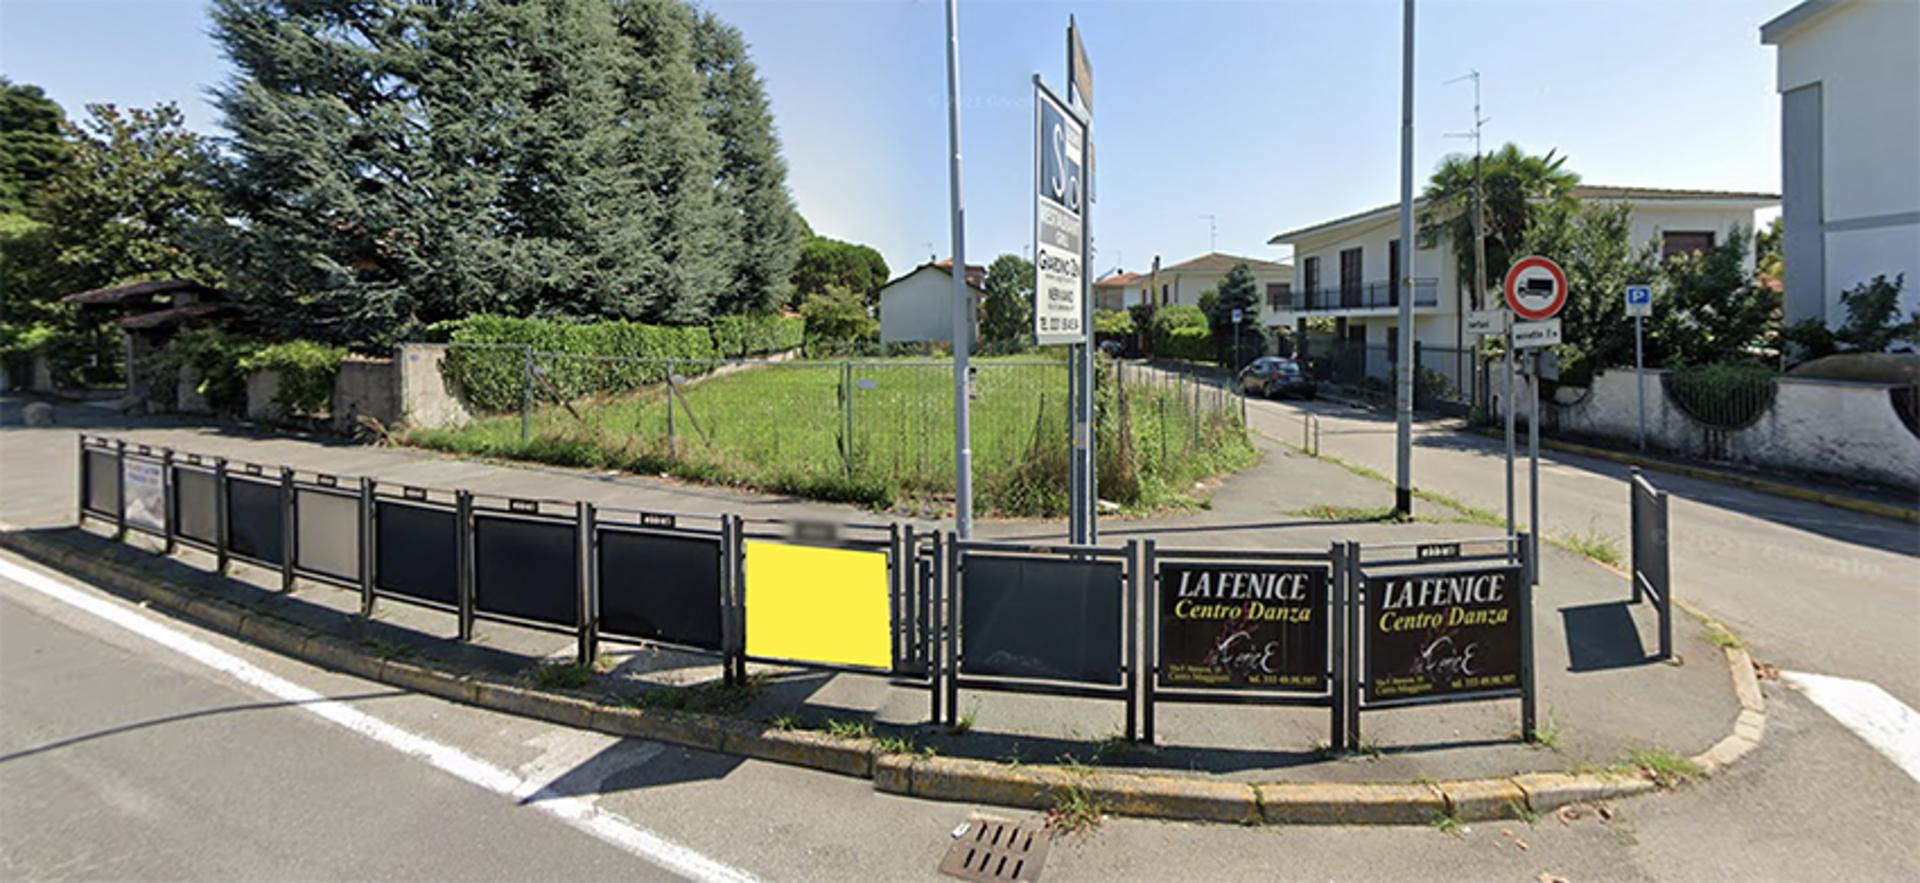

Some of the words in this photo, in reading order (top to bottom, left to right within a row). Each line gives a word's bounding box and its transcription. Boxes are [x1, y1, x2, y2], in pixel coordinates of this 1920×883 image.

[1178, 571, 1212, 597] LA
[1216, 572, 1309, 600] FENICE
[1382, 580, 1412, 609] LA
[1418, 574, 1505, 606] FENICE
[1175, 600, 1241, 620] Centro
[1248, 601, 1312, 623] Danza
[1379, 610, 1443, 632] Centro
[1448, 606, 1509, 626] Danza
